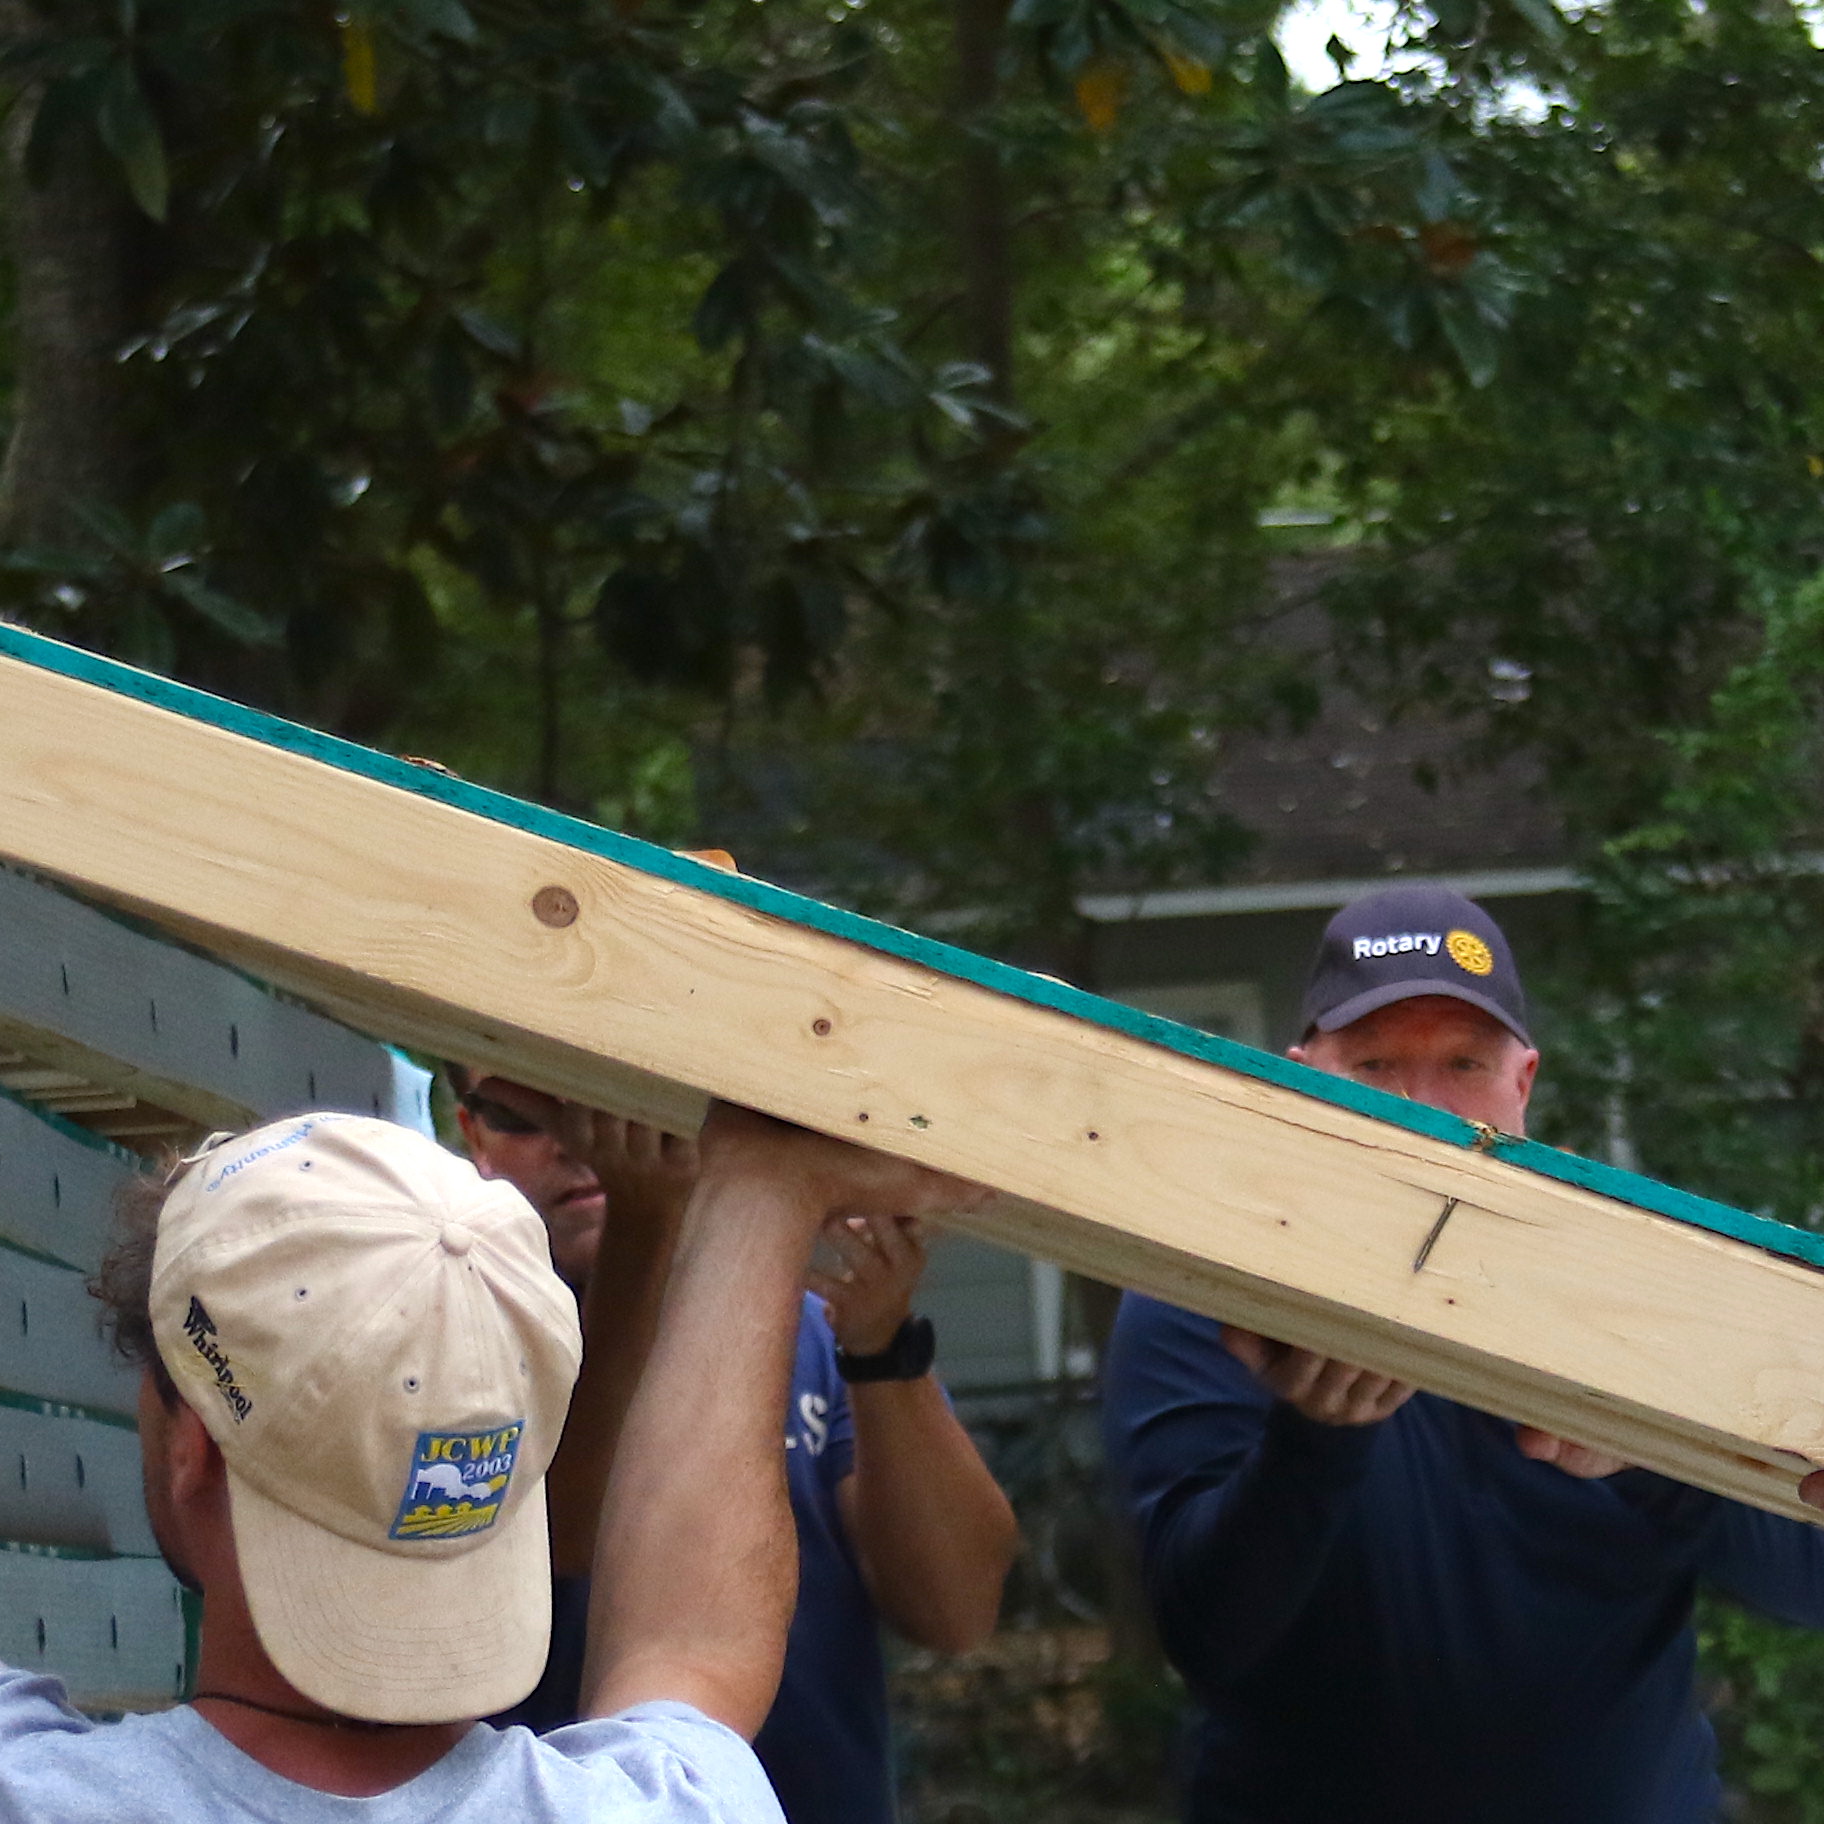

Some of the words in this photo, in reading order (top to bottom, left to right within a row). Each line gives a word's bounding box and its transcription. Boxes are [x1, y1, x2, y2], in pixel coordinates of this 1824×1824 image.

[1353, 932, 1442, 960] Rotary
[183, 1305, 252, 1425] Whirlpool
[421, 1427, 520, 1463] JCWP
[463, 1453, 513, 1480] 2003
